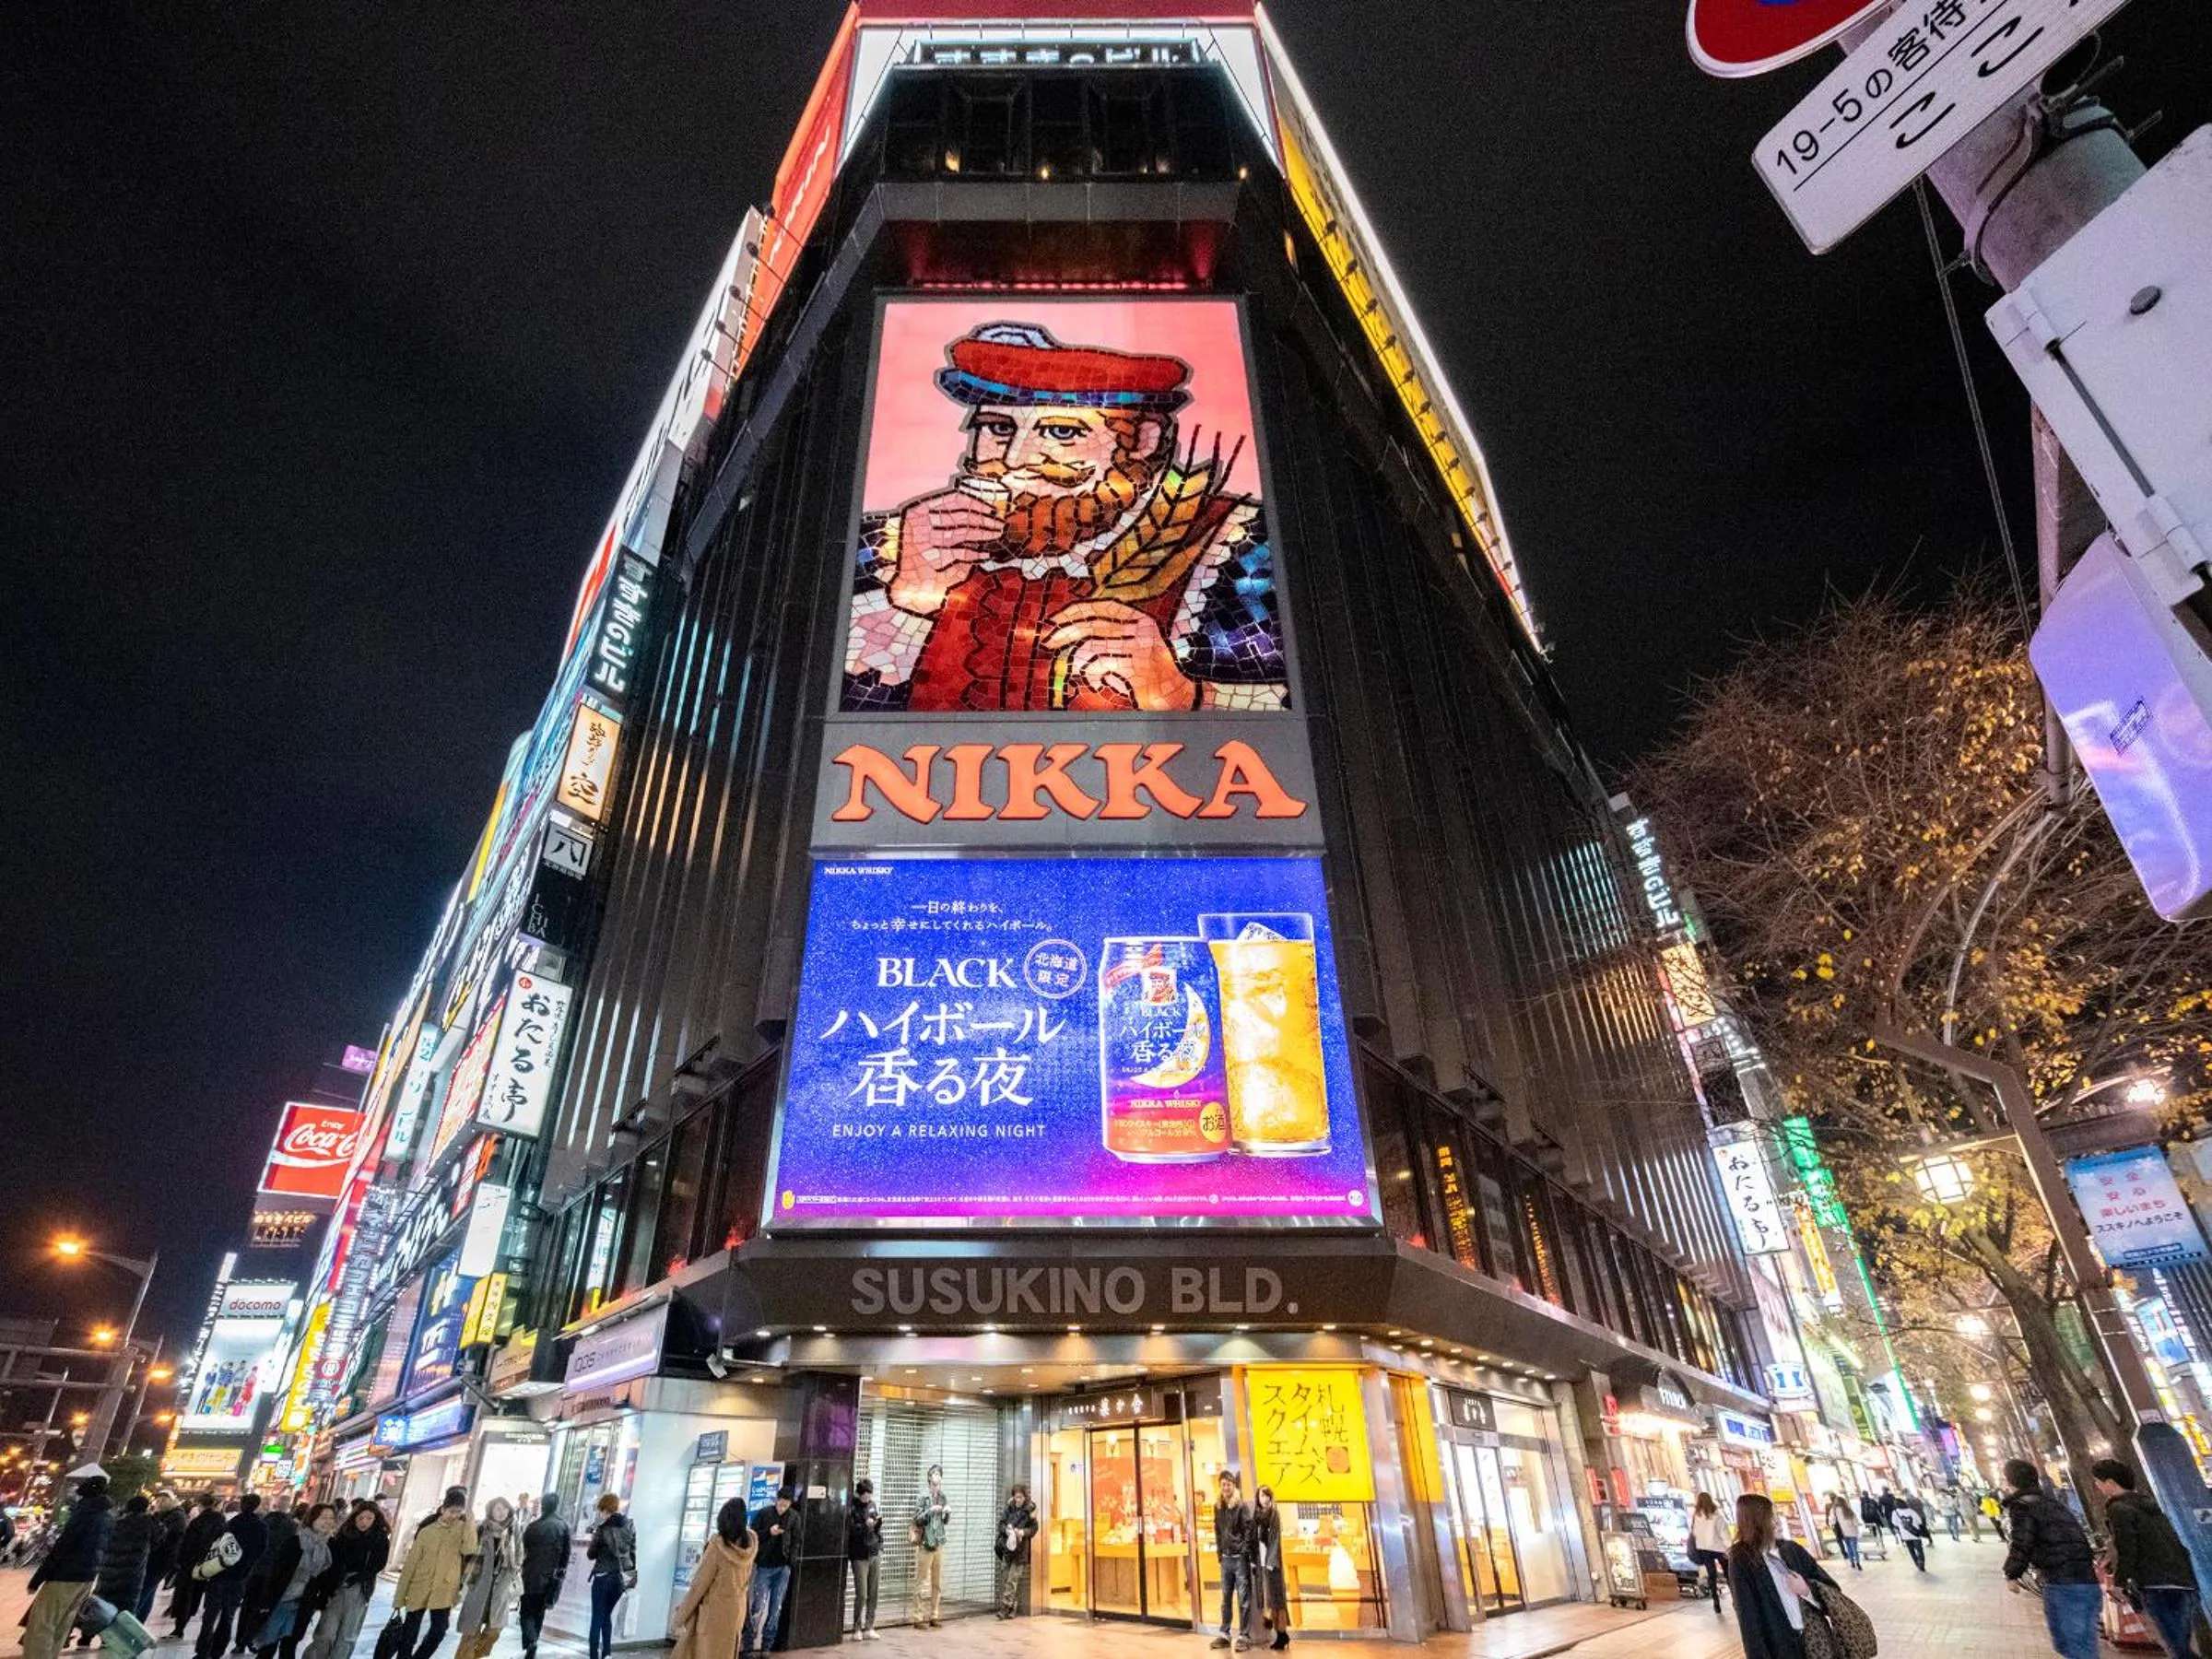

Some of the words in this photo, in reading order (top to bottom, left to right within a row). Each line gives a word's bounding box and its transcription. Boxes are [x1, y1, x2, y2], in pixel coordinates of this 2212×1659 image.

[1777, 0, 1977, 175] 19-5の客待
[1889, 0, 2083, 150] ここ
[831, 738, 1309, 825] NIKKA
[912, 900, 1003, 914] 一日の終わりを、
[851, 918, 1053, 933] ちょっと幸せにしてくれるハイボール。
[877, 958, 1018, 988] BLACK
[1034, 953, 1077, 972] 北海道
[1036, 971, 1070, 987] 限定
[820, 1001, 1068, 1045] ハイボール
[1120, 1018, 1206, 1040] ハイボール
[501, 993, 550, 1123] おたる亭
[1129, 1040, 1198, 1064] 香る夜
[849, 1047, 1034, 1107] 香る夜
[284, 1123, 359, 1158] Coca-C
[832, 1124, 886, 1137] ENJOY
[890, 1124, 902, 1137] A
[909, 1124, 988, 1137] RELAXING
[995, 1124, 1047, 1137] NIGHT
[2096, 1211, 2183, 1233] ススキノへようこそ
[229, 1297, 281, 1310] docomo
[851, 1266, 1146, 1315] SUSUKINO
[1171, 1266, 1300, 1315] BLD.
[1263, 1384, 1293, 1488] スクエア
[1290, 1382, 1324, 1486] タイムズ
